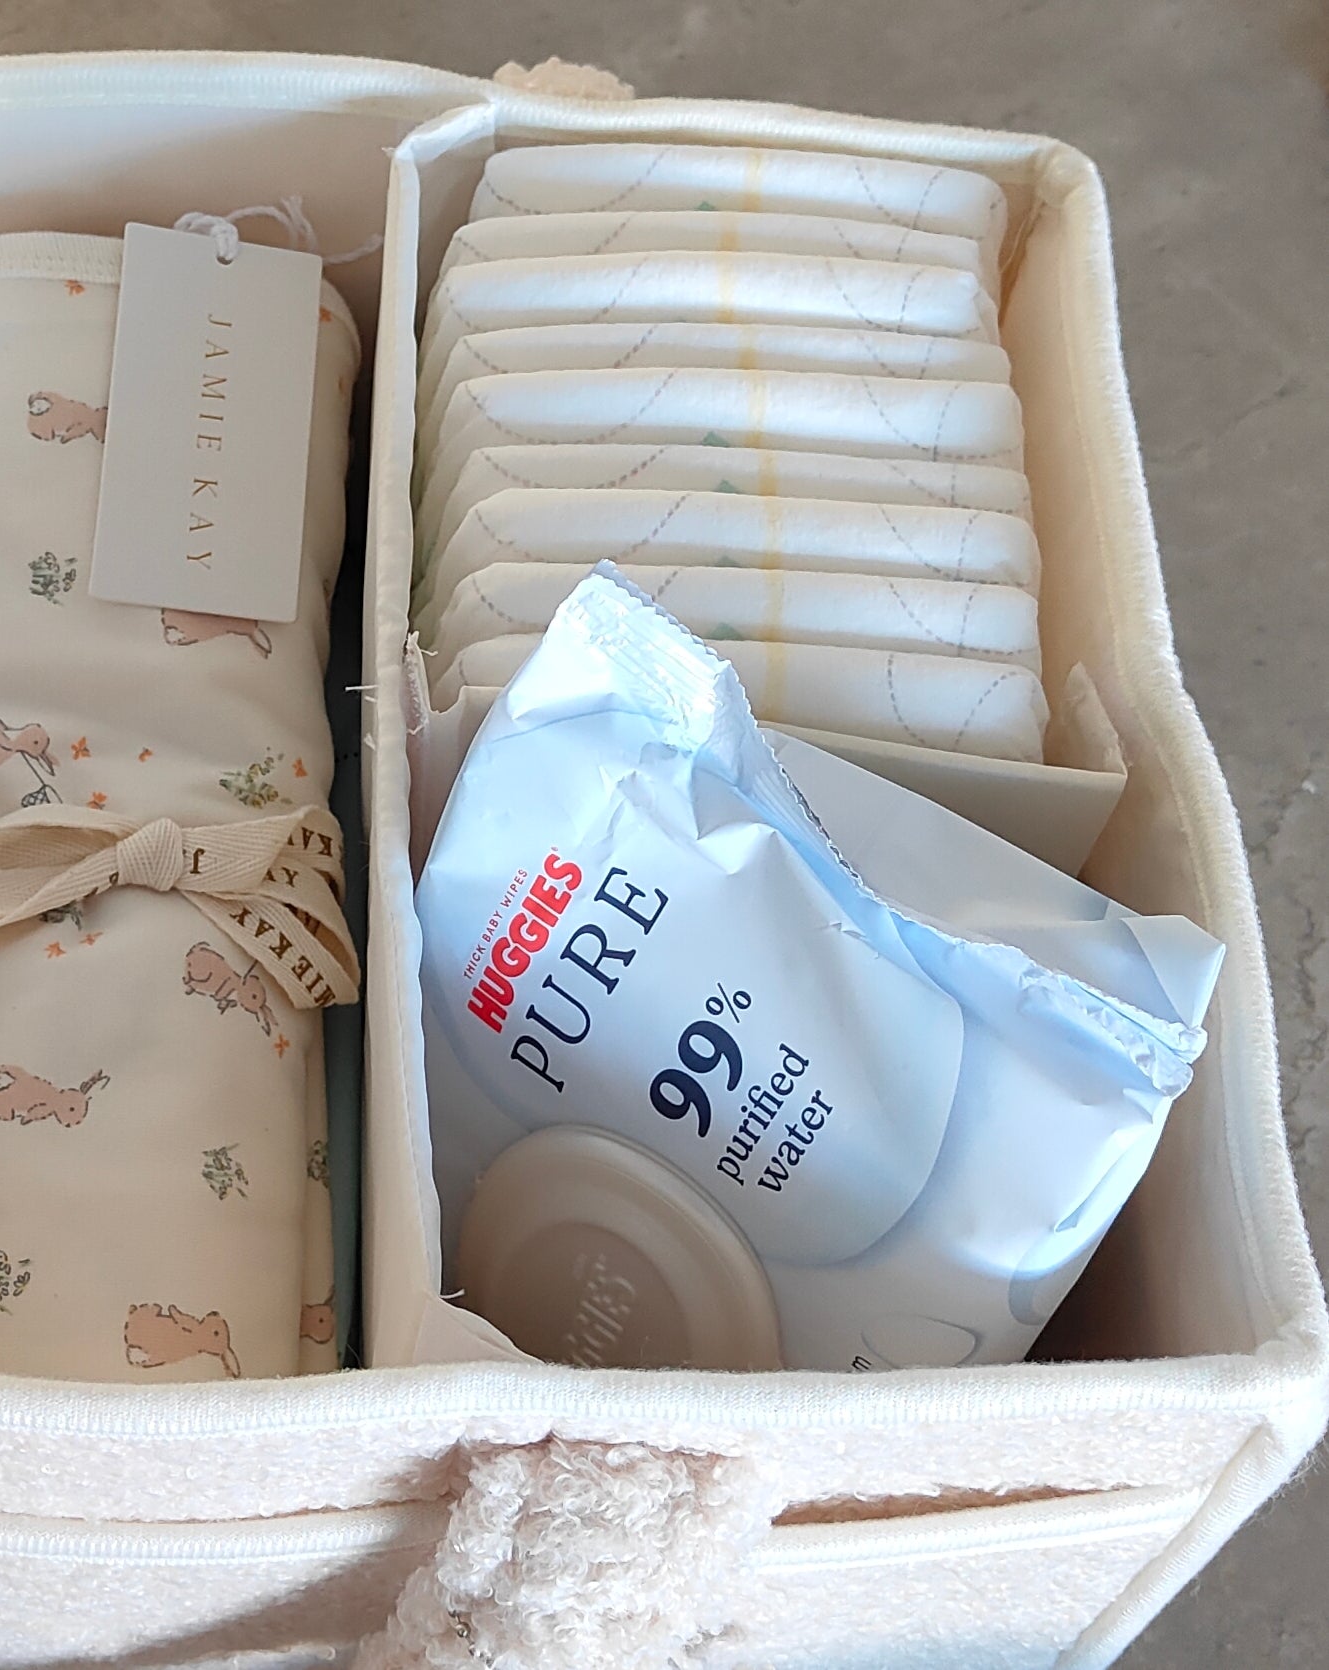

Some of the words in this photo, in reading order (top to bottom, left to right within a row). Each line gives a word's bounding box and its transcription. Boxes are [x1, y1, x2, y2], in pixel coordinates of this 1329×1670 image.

[196, 313, 232, 452] JAMIE
[186, 478, 218, 570] KAY
[463, 944, 486, 980] THICK
[482, 910, 504, 943] BABY
[500, 868, 528, 908] WIPES
[467, 853, 583, 1034] HUGGIES
[510, 866, 669, 1093] PURE
[650, 982, 752, 1138] 99%
[716, 1043, 810, 1187] purified
[757, 1089, 834, 1193] water
